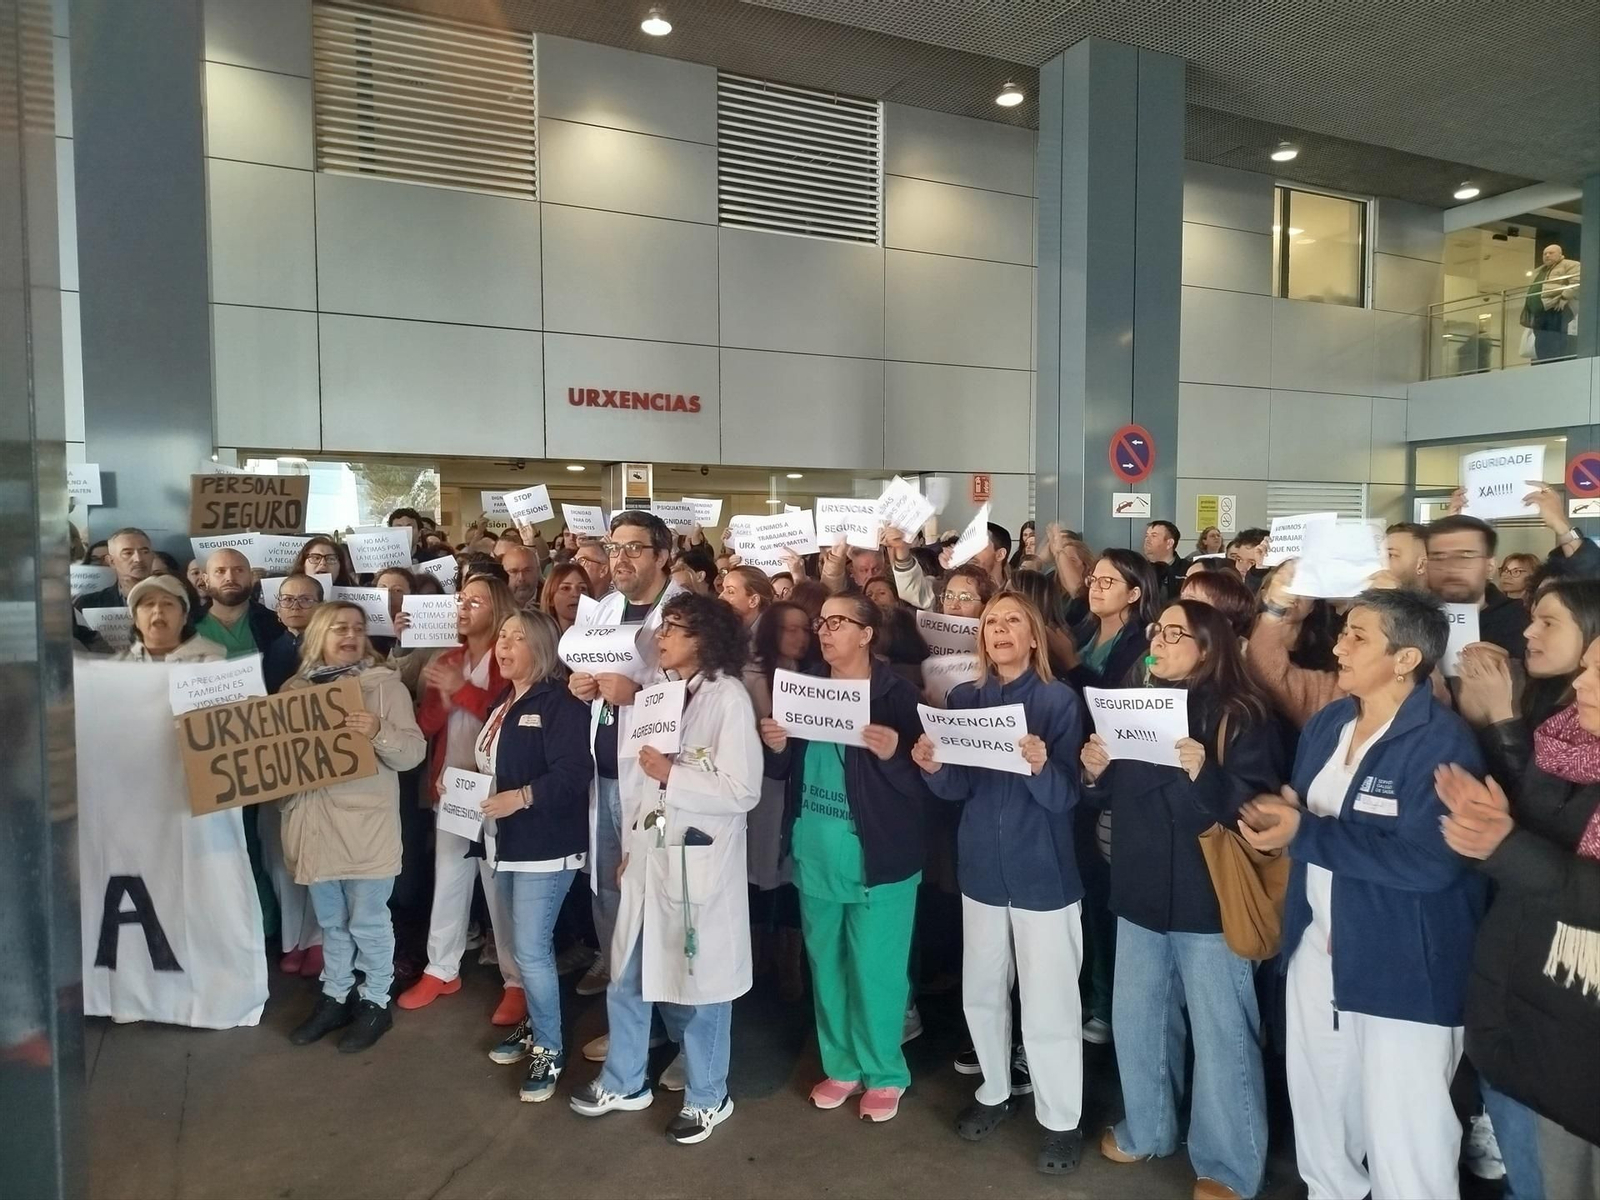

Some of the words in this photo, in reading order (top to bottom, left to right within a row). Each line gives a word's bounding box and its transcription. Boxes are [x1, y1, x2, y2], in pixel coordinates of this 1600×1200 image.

[568, 387, 701, 413] URXENCIAS
[201, 477, 292, 496] PERSOAL
[514, 493, 532, 502] STOP
[201, 499, 302, 530] SEGURO
[821, 504, 874, 515] URXENCIAS
[756, 523, 783, 532] VENIMOS
[824, 524, 868, 534] SEGURAS
[199, 538, 254, 549] SEGURIDADE
[357, 545, 386, 553] VÍCTIMAS
[787, 538, 809, 547] MATEN
[424, 563, 443, 574] STOP
[338, 592, 382, 601] PSIQUIATRÍA
[436, 599, 452, 608] MÁS
[411, 610, 446, 619] VÍCTIMAS
[585, 628, 616, 636] STOP
[920, 618, 979, 636] URXENCIAS
[414, 632, 427, 640] DEL
[566, 650, 633, 663] AGRESIÓNS
[177, 680, 188, 689] LA
[190, 666, 254, 686] PRECARIEDAD
[188, 682, 230, 698] TAMBIÉN
[232, 679, 244, 688] ES
[780, 681, 861, 702] URXENCIAS
[645, 692, 664, 707] STOP
[1094, 697, 1174, 710] SEGURIDADE
[184, 688, 347, 751] URXENCIAS
[785, 712, 854, 730] SEGURAS
[926, 713, 1016, 727] URXENCIAS
[631, 720, 677, 739] AGRESIÓNS
[1115, 728, 1158, 742] XA!!!!!
[940, 736, 1014, 752] SEGURAS
[210, 733, 358, 804] SEGURAS
[455, 778, 476, 791] STOP
[95, 875, 184, 972] A
